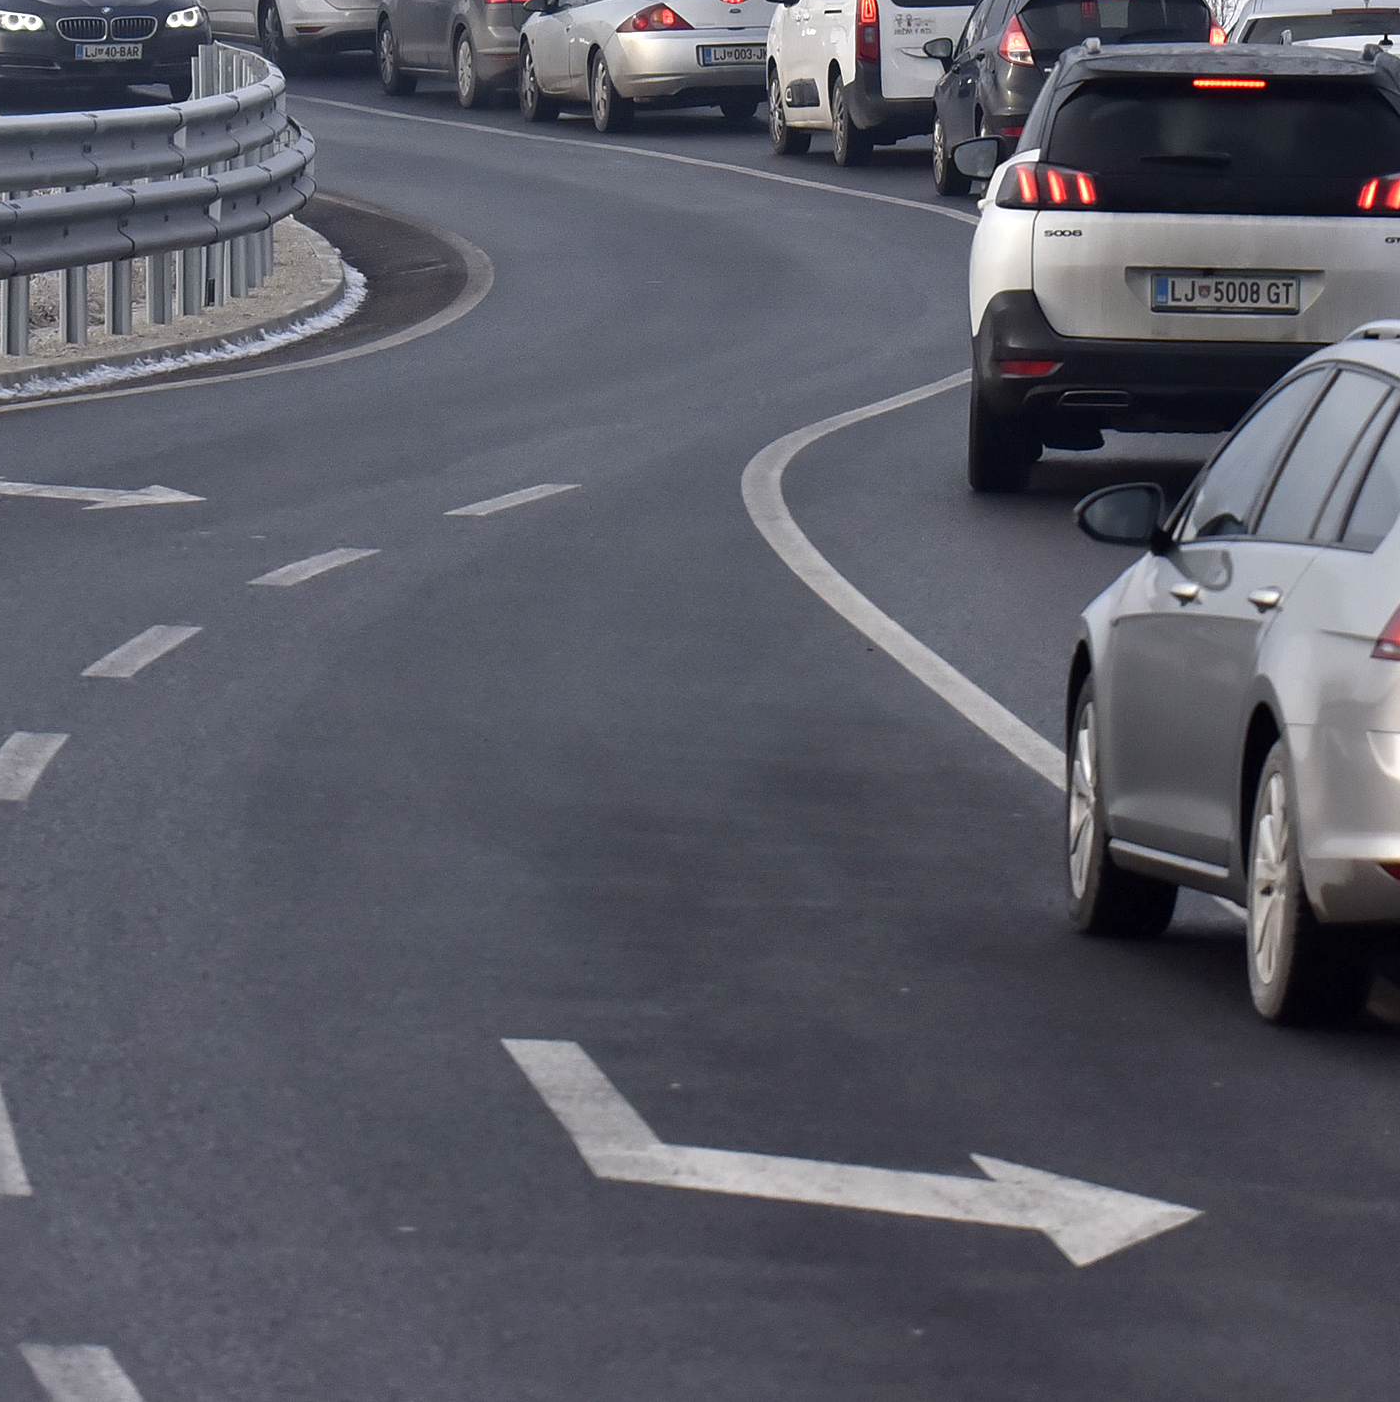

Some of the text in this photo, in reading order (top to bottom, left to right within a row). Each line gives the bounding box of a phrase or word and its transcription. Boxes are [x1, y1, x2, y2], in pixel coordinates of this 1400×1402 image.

[85, 46, 140, 58] LJ 40-BAR
[714, 49, 726, 61] LJ
[1044, 229, 1083, 238] 5008
[1171, 280, 1293, 305] LJ 5008 GT
